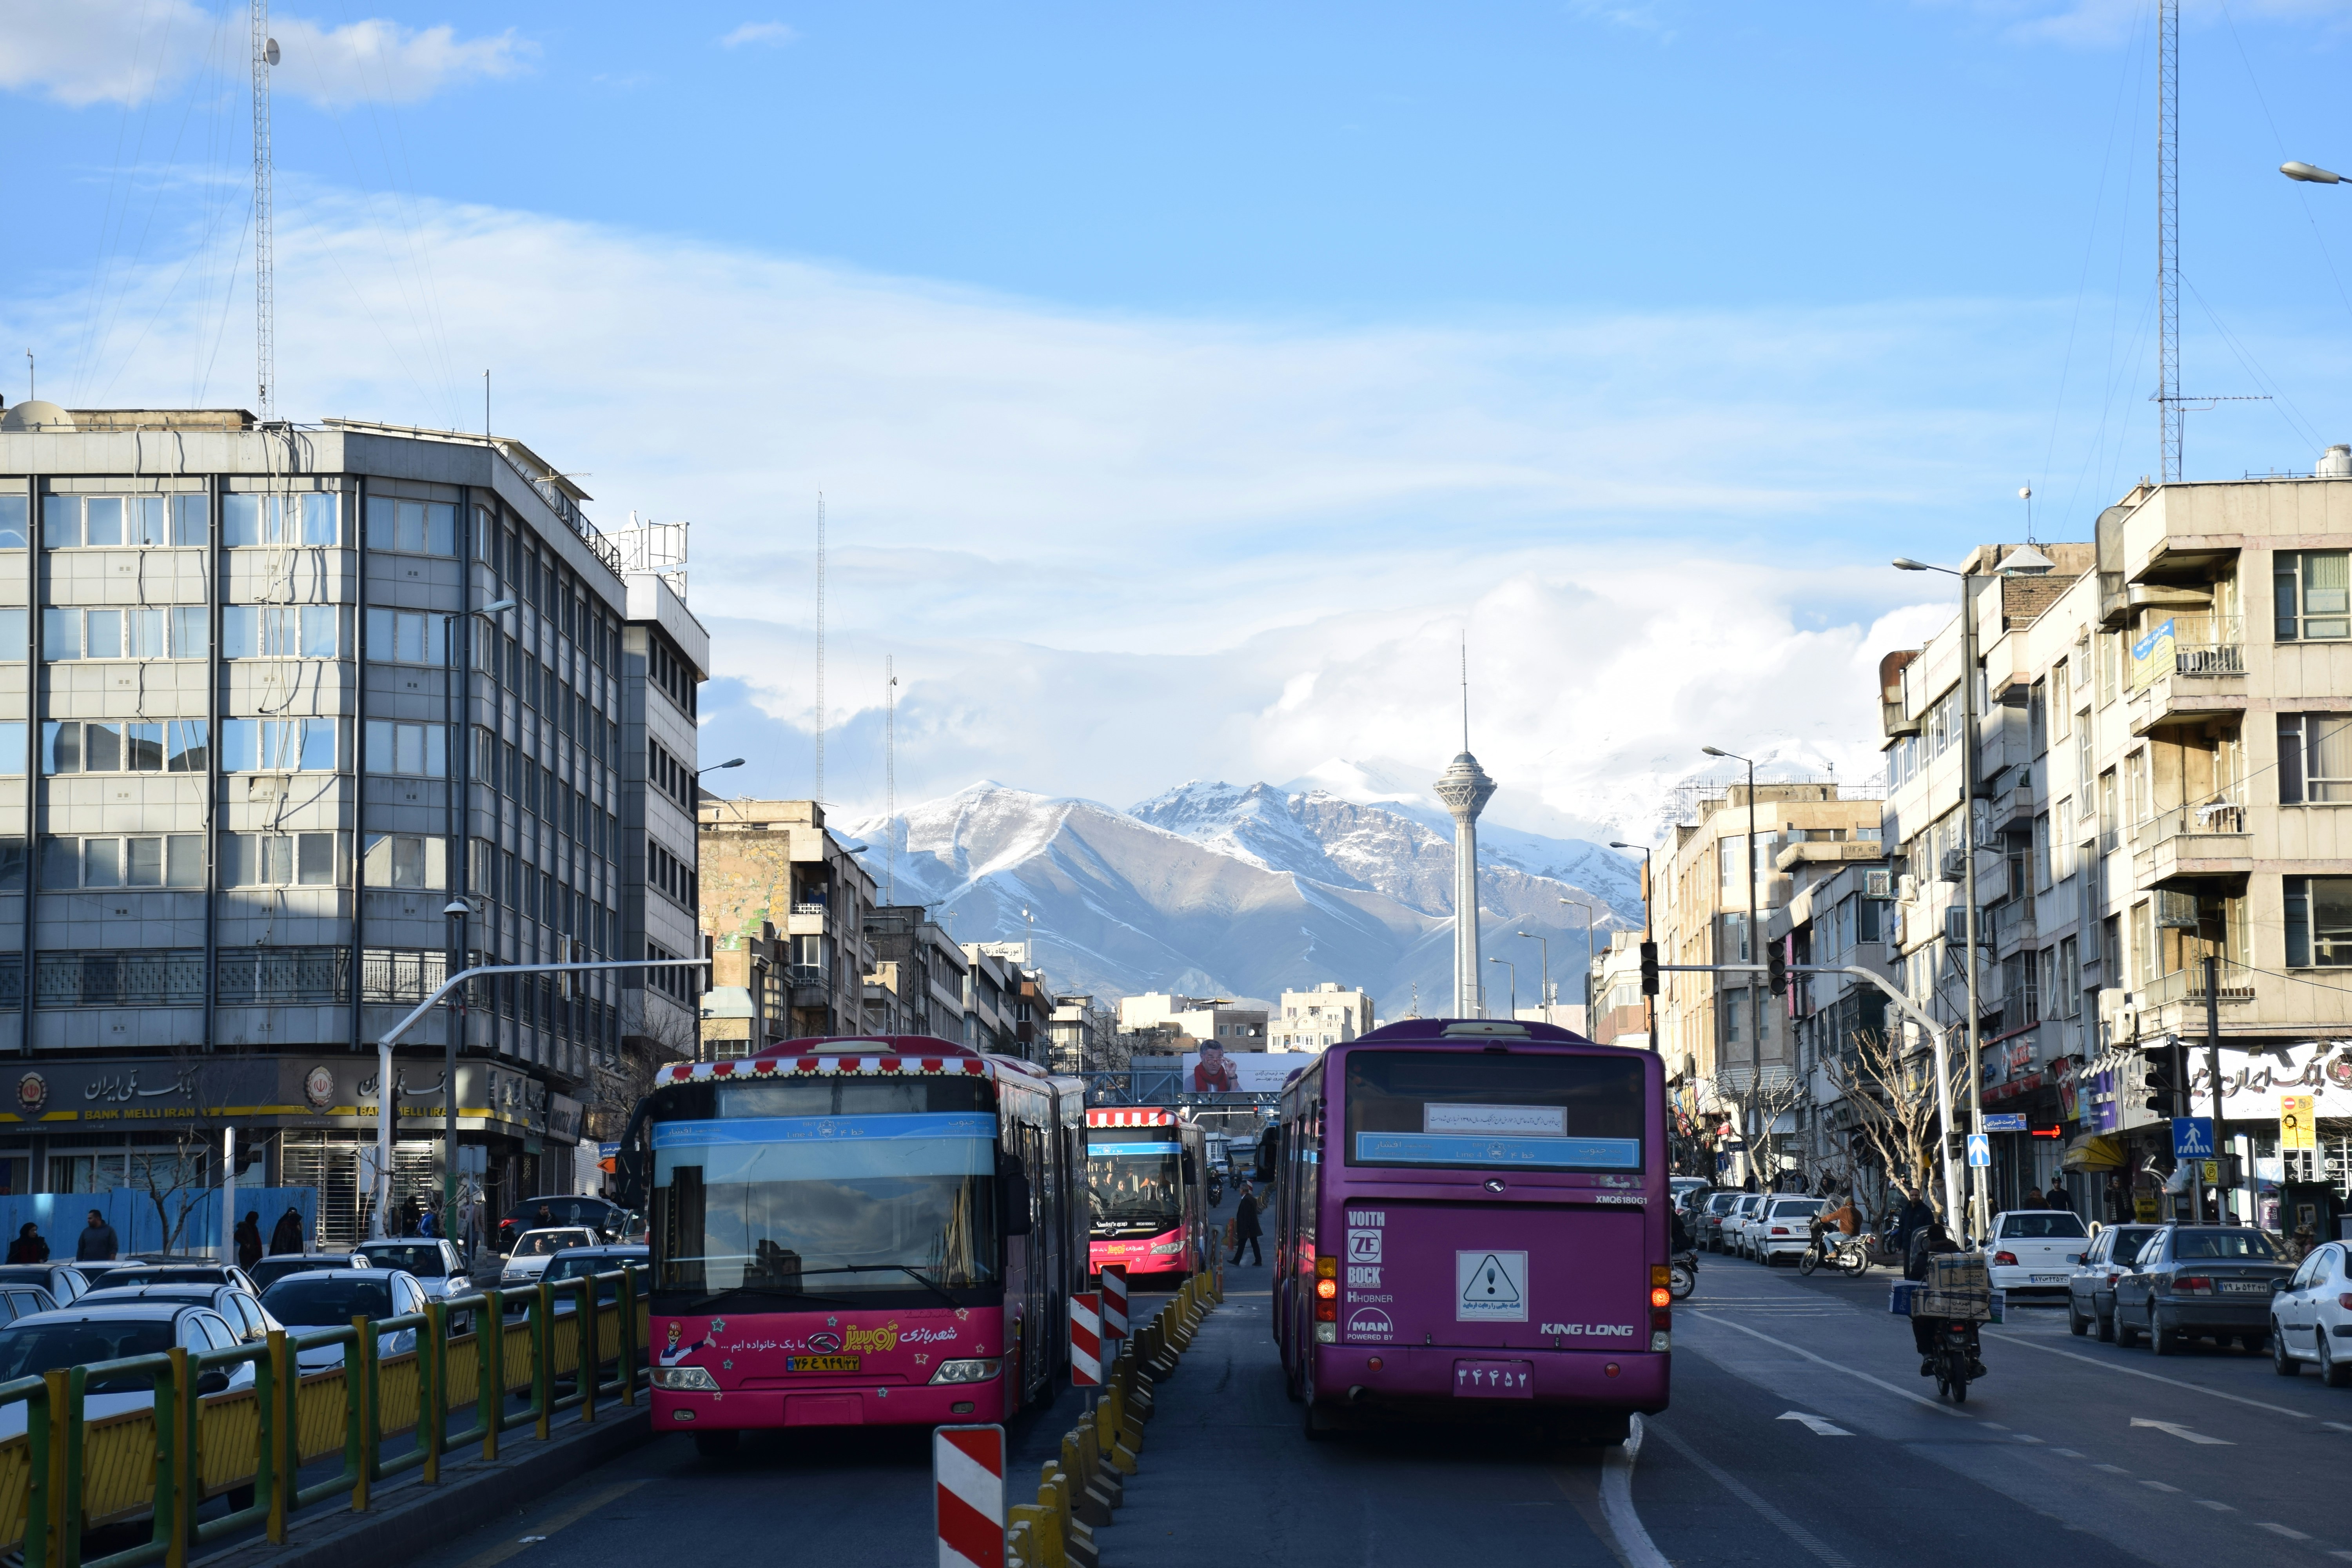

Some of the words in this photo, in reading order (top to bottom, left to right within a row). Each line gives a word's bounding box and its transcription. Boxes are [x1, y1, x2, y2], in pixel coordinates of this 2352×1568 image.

[995, 947, 1024, 956] آموزشگاه
[85, 1075, 120, 1101] ایران
[138, 1064, 199, 1100] بانک
[84, 1109, 120, 1120] BANK
[124, 1108, 161, 1119] MELLI
[164, 1107, 195, 1117] IRAN
[360, 1106, 380, 1116] BAN
[430, 1107, 446, 1117] IRA
[949, 1119, 975, 1127] جنوب
[668, 1127, 691, 1137] افشار
[1374, 1140, 1402, 1150] افشار
[1579, 1147, 1606, 1155] جنوب
[1595, 1196, 1648, 1205] XMQ6180G1
[1348, 1211, 1385, 1227] VOITH
[1352, 1236, 1378, 1255] ZF
[1348, 1267, 1381, 1283] BOCK
[1352, 1322, 1388, 1332] MAN
[1541, 1323, 1583, 1335] KING
[1585, 1325, 1634, 1336] LONG
[900, 1326, 958, 1345] شهربازی
[731, 1340, 744, 1353] ایم
[746, 1340, 777, 1352] خانواده
[780, 1339, 795, 1351] یک
[798, 1339, 805, 1348] ما
[845, 1359, 858, 1370] ۲۲
[1458, 1368, 1526, 1388] ۳۴۴۵۲
